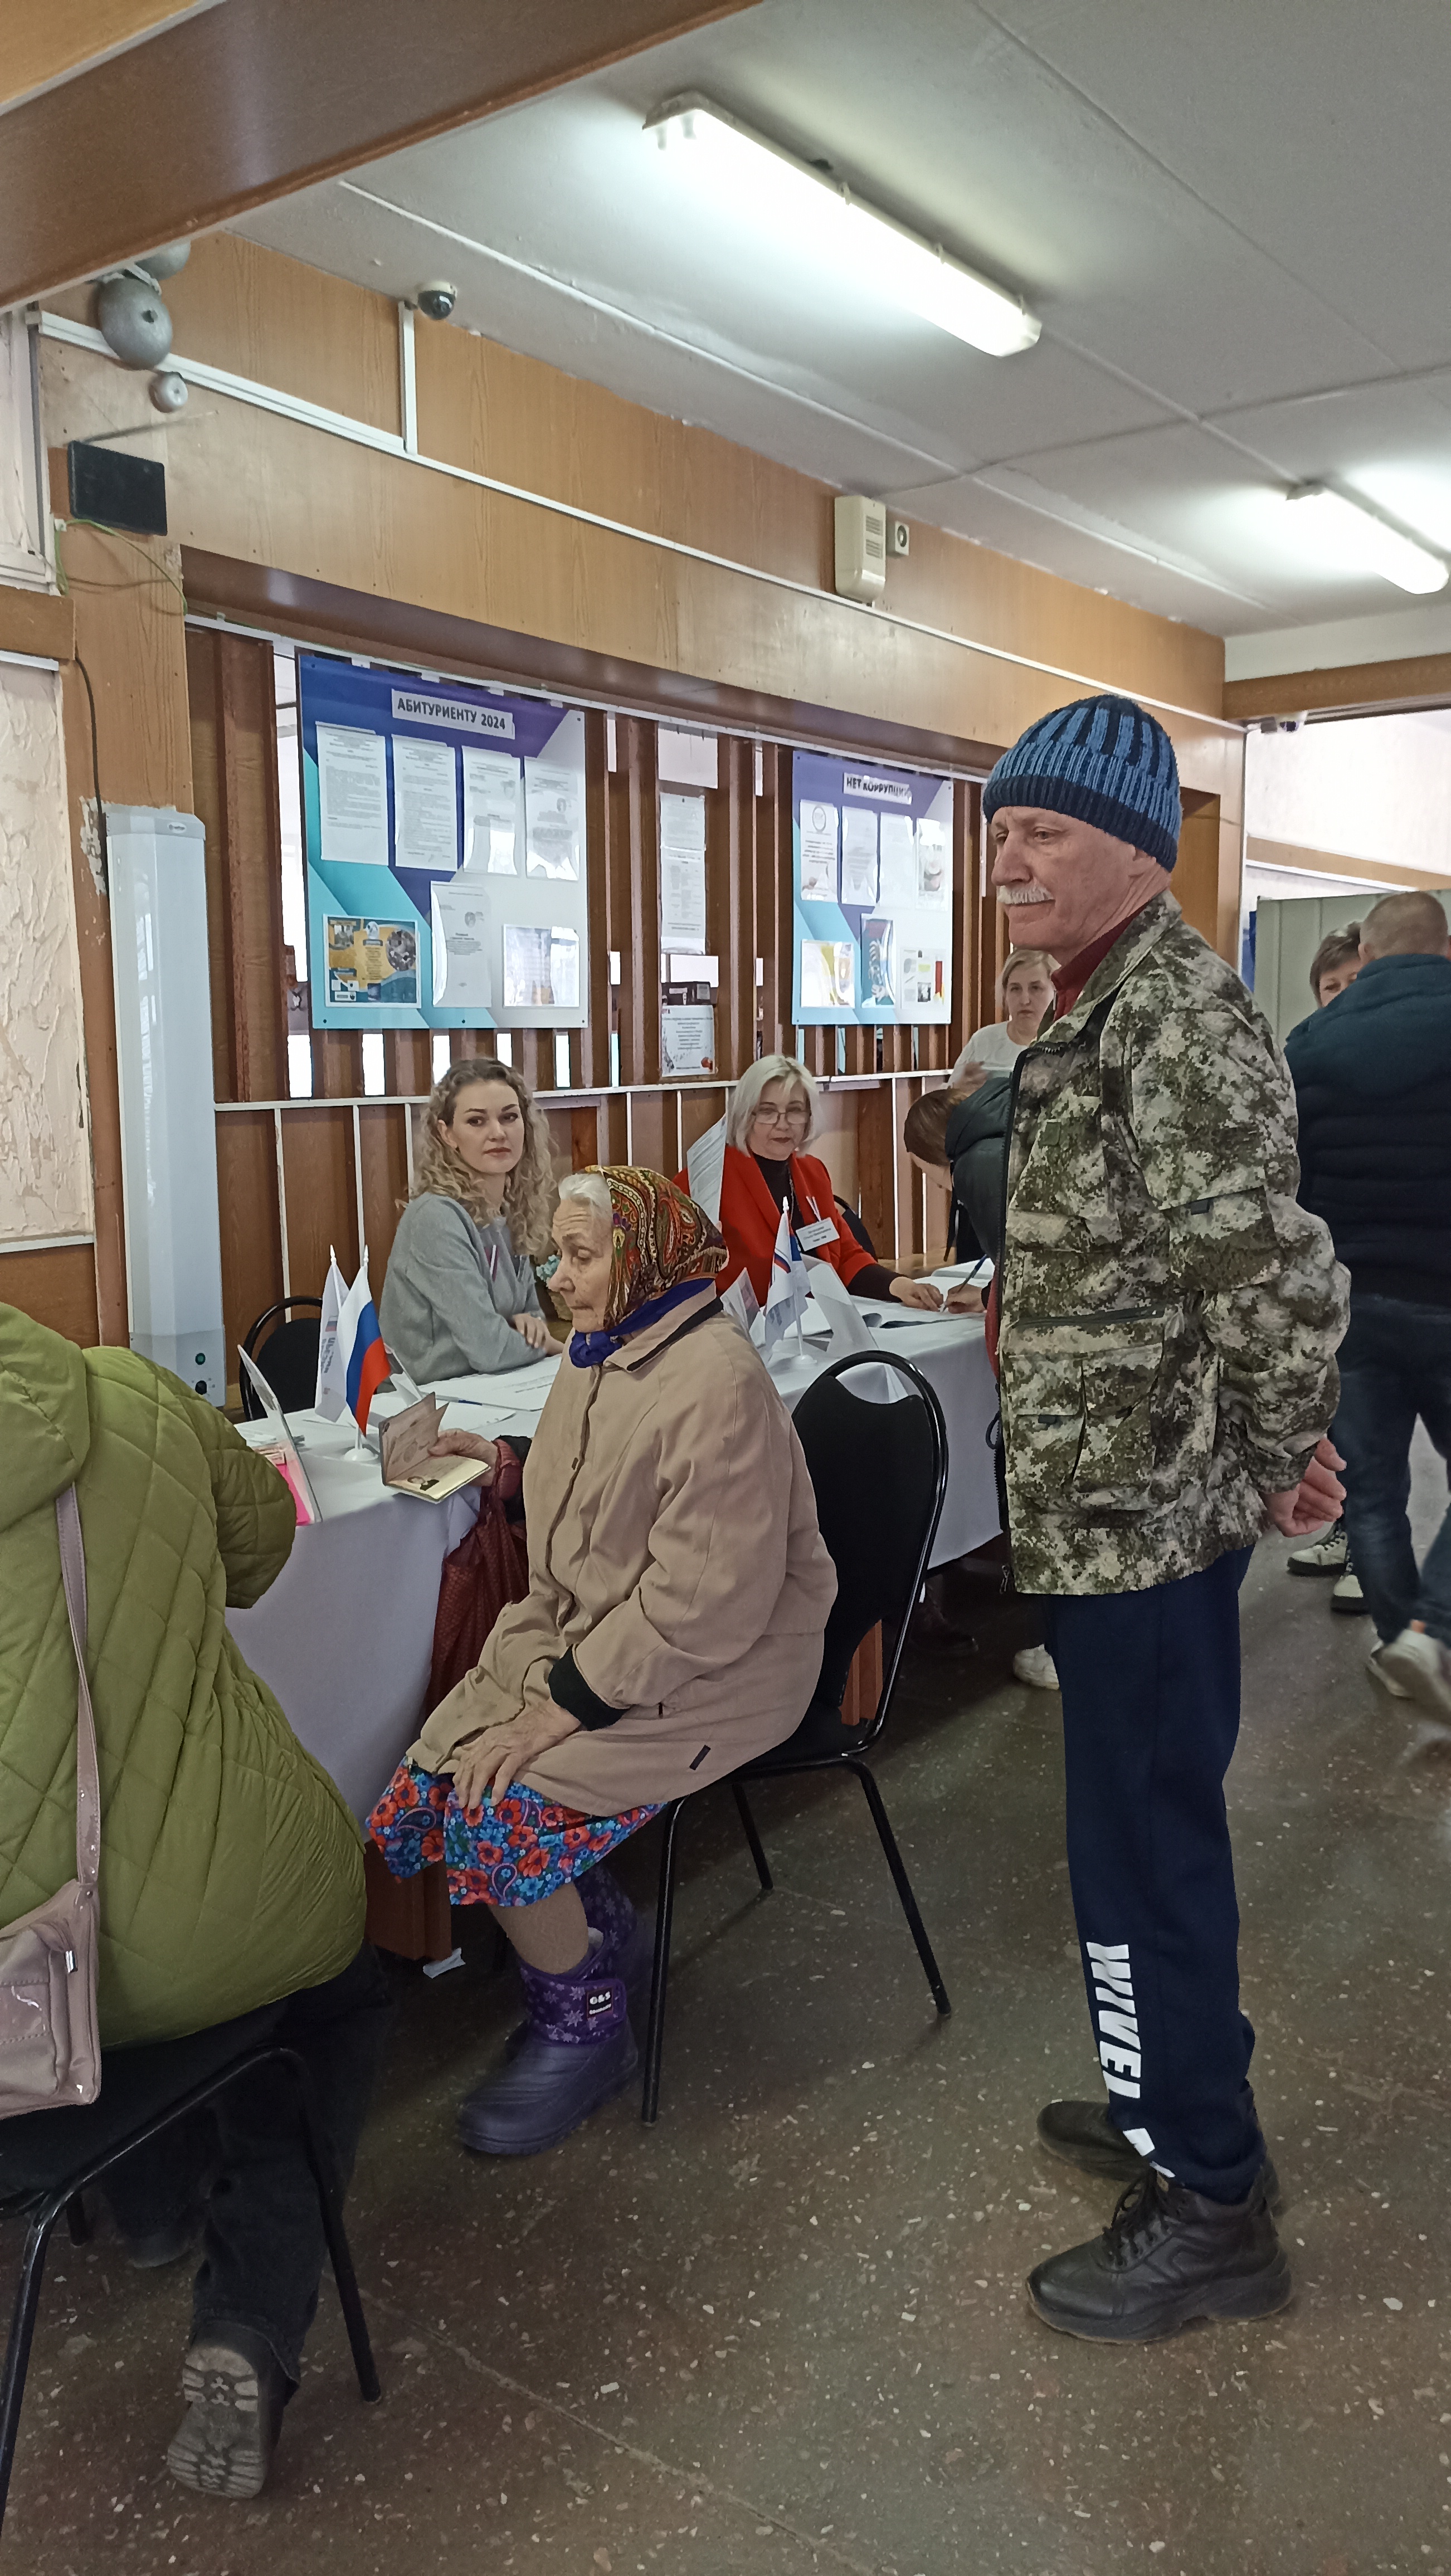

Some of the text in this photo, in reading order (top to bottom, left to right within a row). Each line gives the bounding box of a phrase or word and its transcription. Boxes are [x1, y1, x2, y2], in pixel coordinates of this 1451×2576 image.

[397, 697, 506, 730] АБИТУРИЕНТУ 2024
[846, 777, 862, 789] НЕТ
